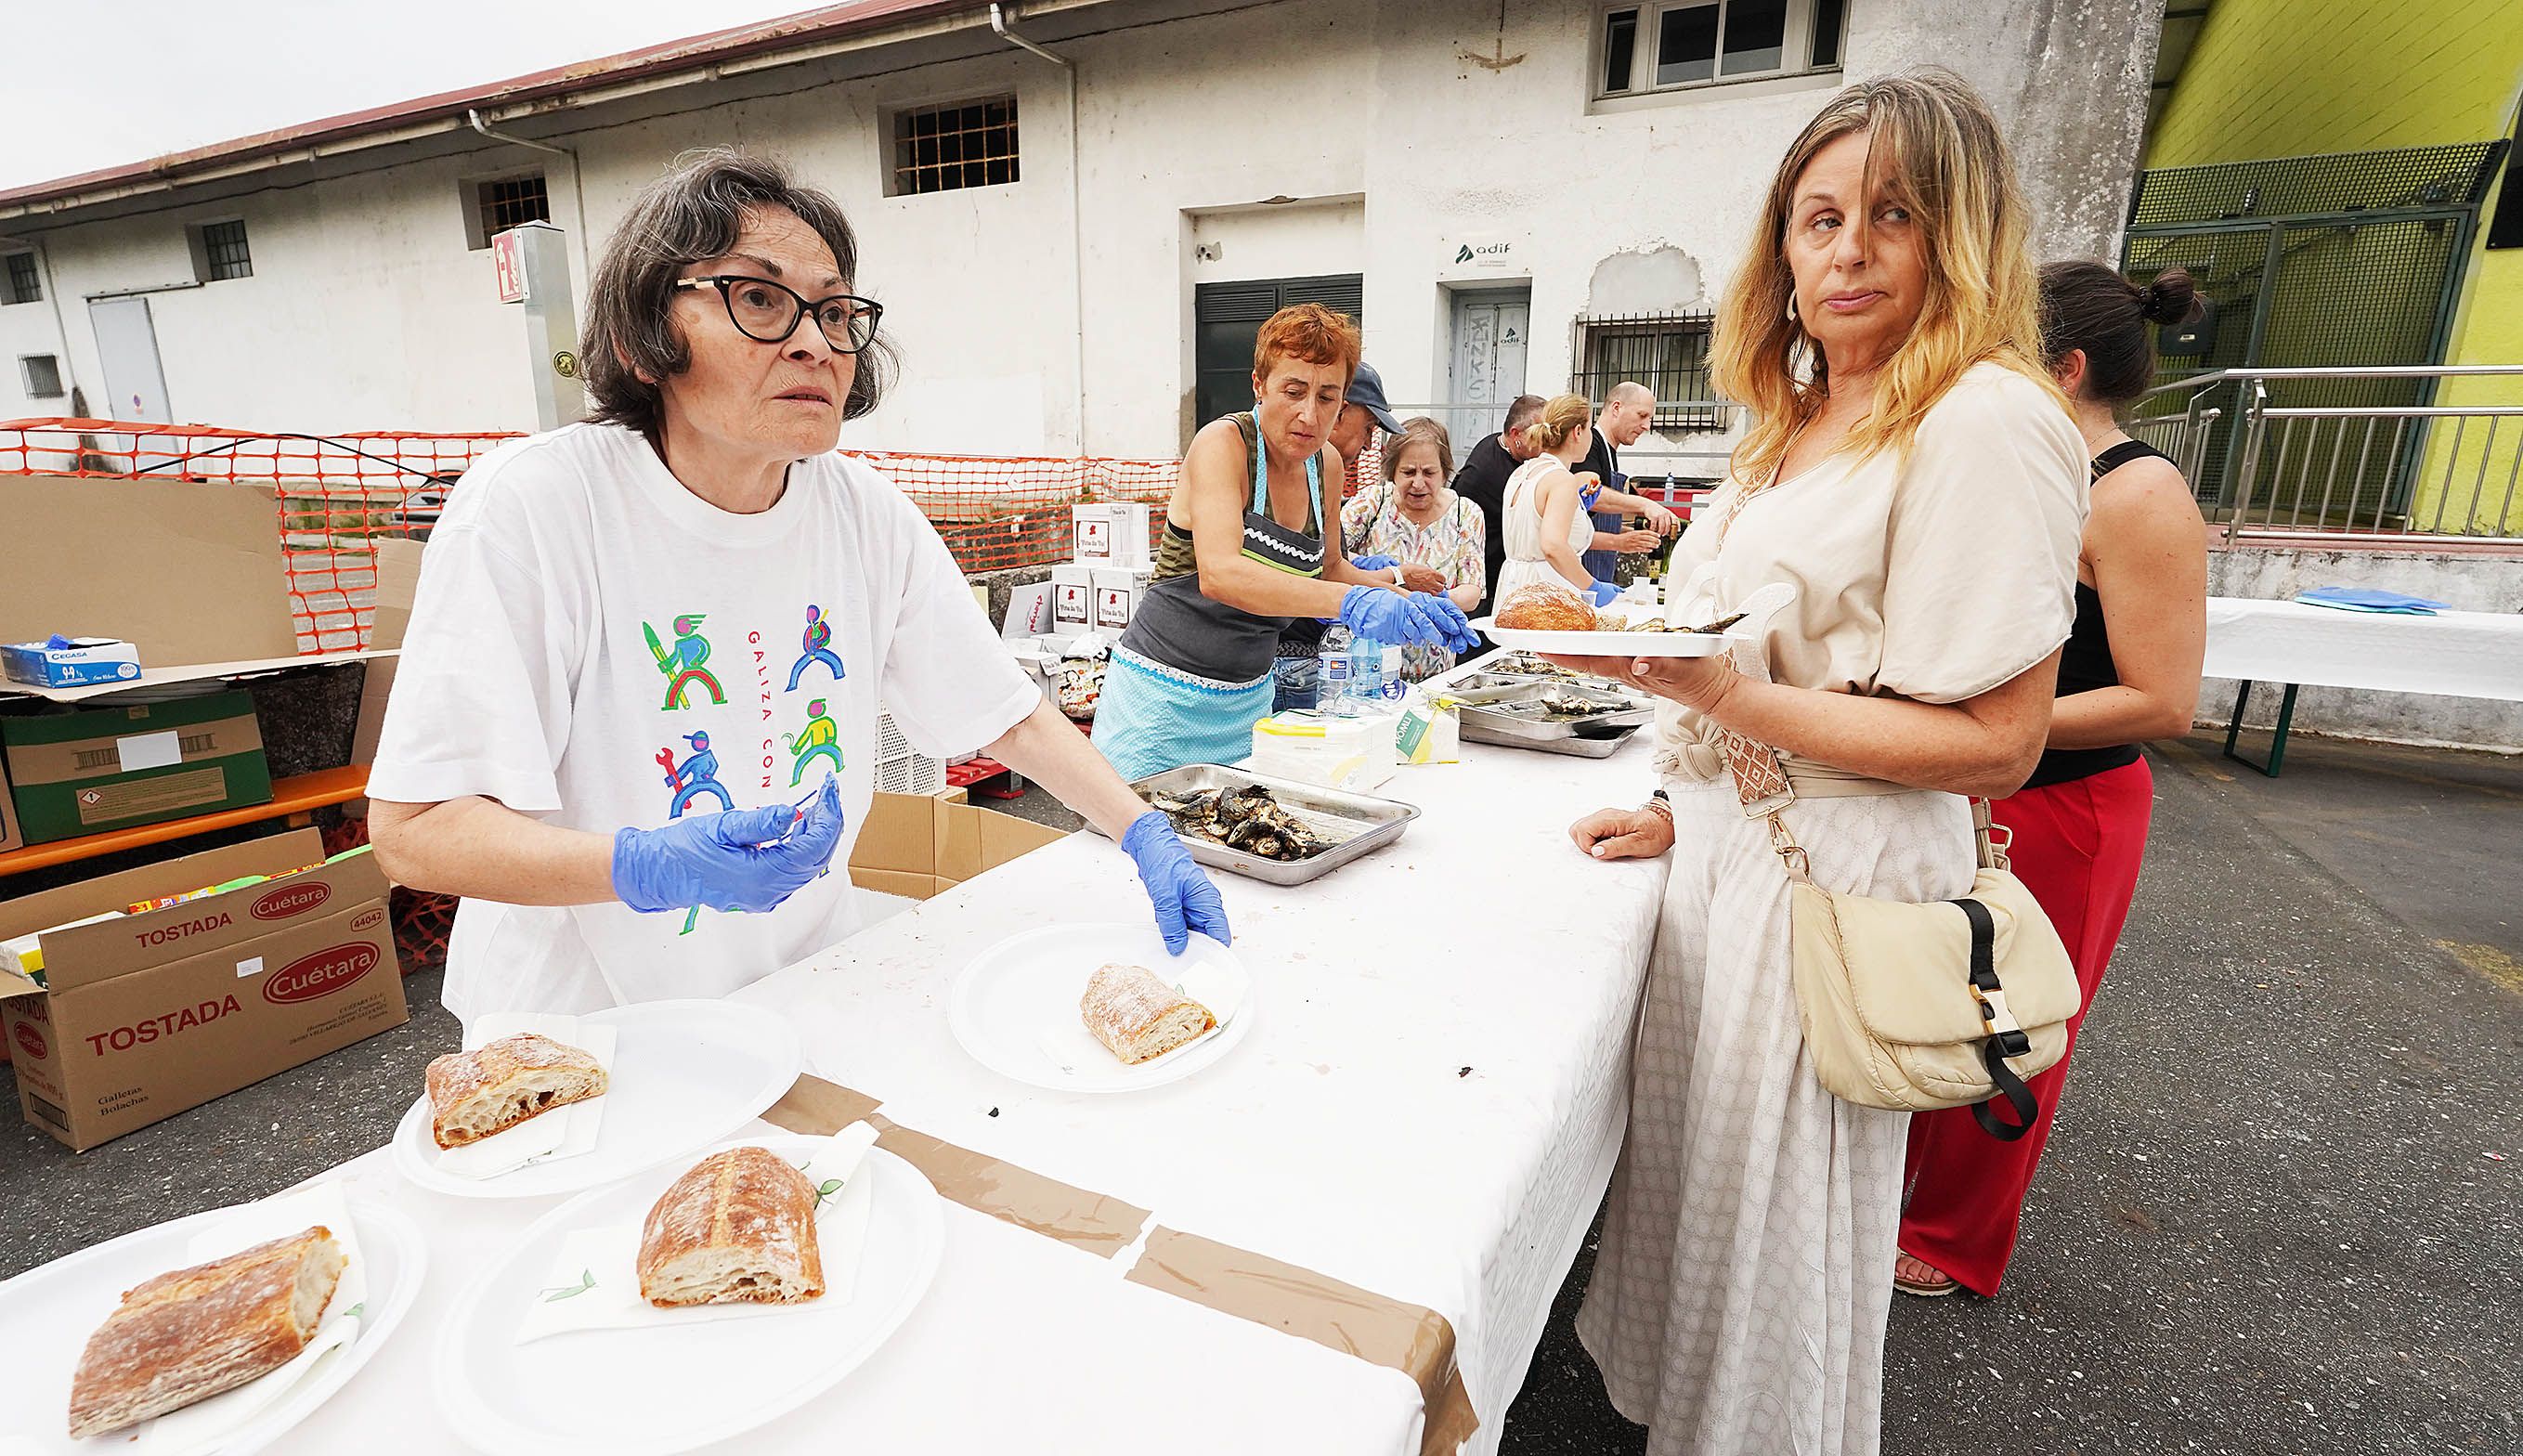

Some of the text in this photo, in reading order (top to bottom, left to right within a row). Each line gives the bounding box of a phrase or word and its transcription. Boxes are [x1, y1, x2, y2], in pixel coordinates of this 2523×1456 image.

[1476, 242, 1511, 254] adif
[51, 652, 88, 660] CEGASA
[748, 630, 774, 787] GALIZA CON
[135, 887, 325, 948] TOSTADA Cuétara
[353, 911, 383, 928] 44042
[271, 950, 372, 997] Cuétara
[5, 995, 50, 1026] OSTADA
[85, 994, 242, 1057] TOSTADA
[98, 1086, 143, 1105] Galletas
[100, 1095, 150, 1116] Bolachas
